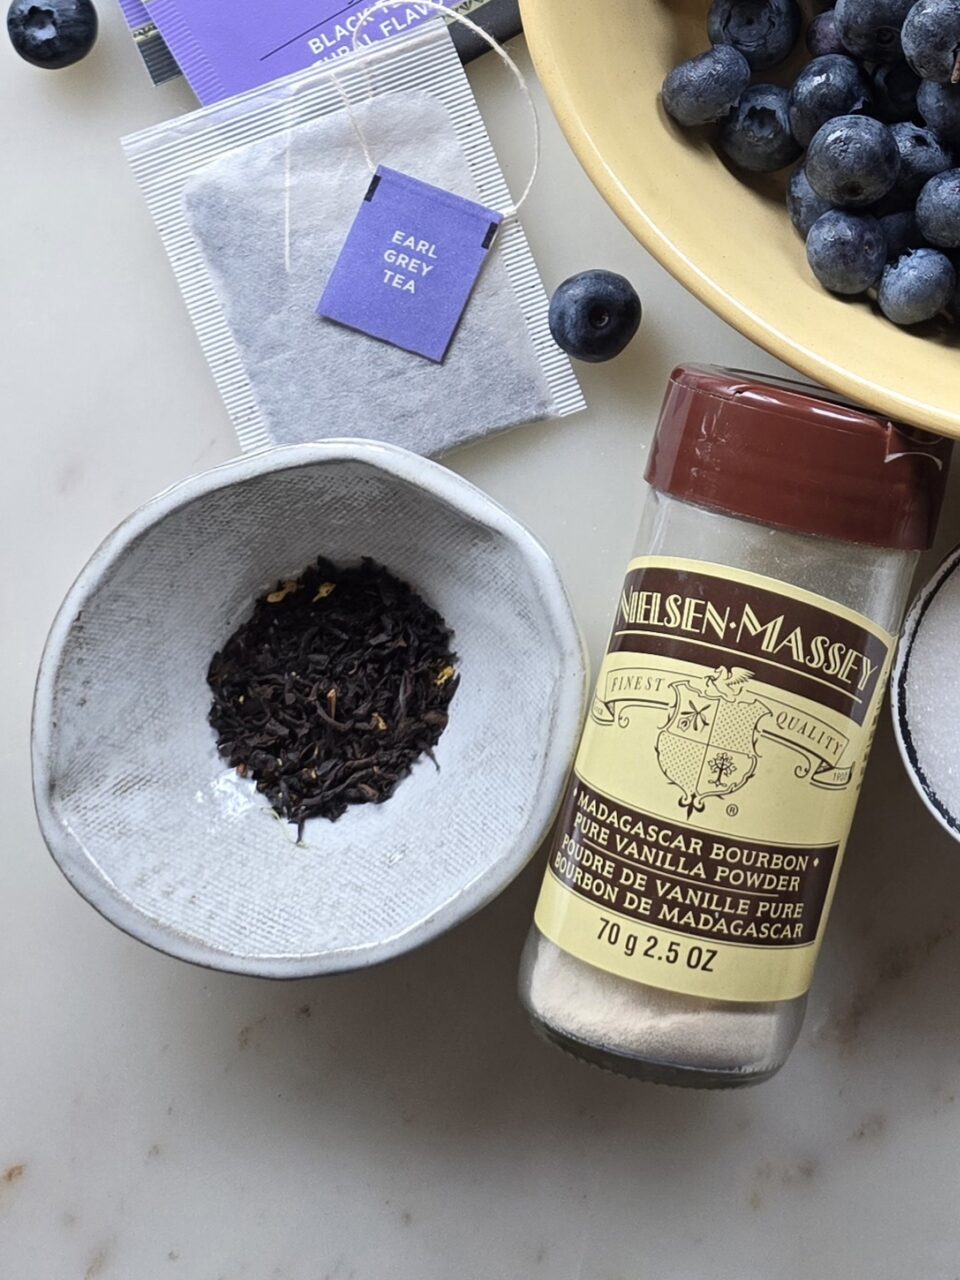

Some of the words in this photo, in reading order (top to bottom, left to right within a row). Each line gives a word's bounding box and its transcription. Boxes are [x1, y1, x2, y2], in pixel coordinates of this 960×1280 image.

[307, 8, 374, 55] BLACK
[383, 249, 434, 277] GREY
[391, 230, 438, 259] EARL
[383, 269, 416, 294] TEA
[611, 675, 664, 692] FINEST
[776, 710, 843, 756] QUALITY
[573, 811, 610, 846] PURE
[614, 835, 707, 880] VANILLA
[714, 866, 801, 893] POWDER
[577, 789, 703, 856] MADAGASCAR
[710, 842, 809, 871] BOURBON
[554, 851, 619, 904] BOURBON
[623, 891, 653, 915] DE
[658, 904, 804, 940] MADAGASCAR
[561, 833, 615, 879] POUDRE
[619, 867, 648, 891] DE
[656, 882, 750, 916] VANILLE
[756, 901, 805, 919] PURE
[597, 917, 621, 946] 70
[624, 933, 638, 957] g
[643, 935, 681, 964] 2.5
[687, 945, 719, 972] OZ
